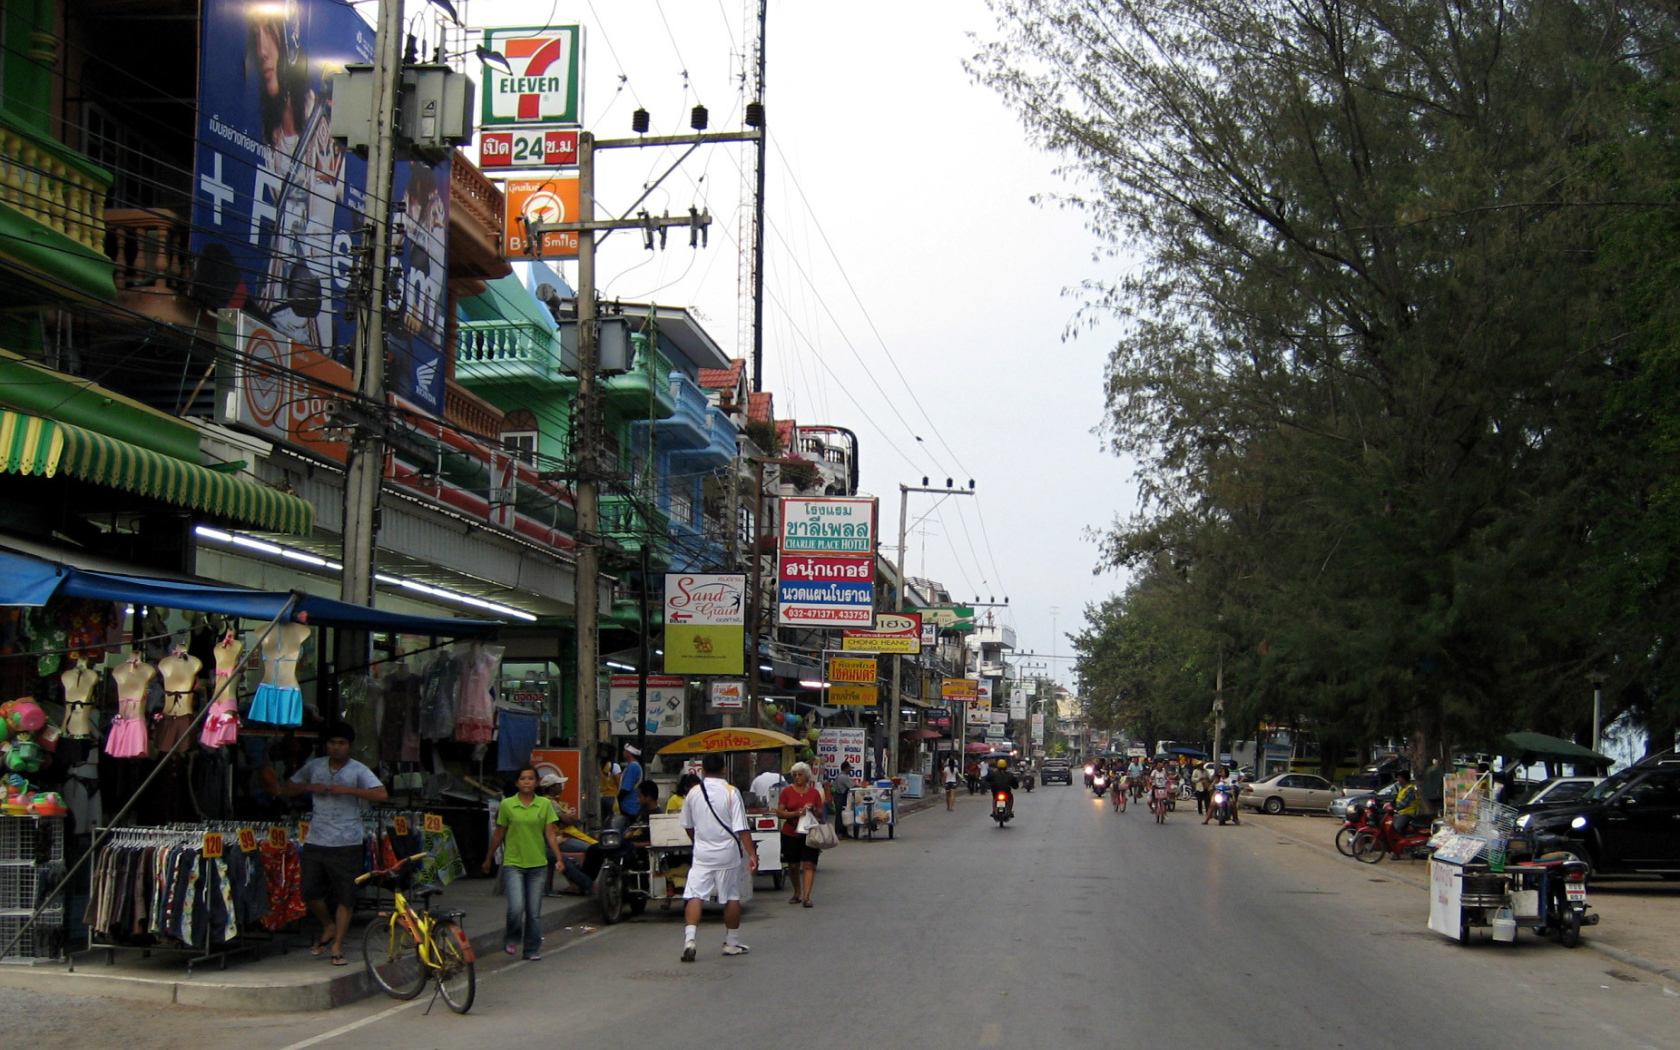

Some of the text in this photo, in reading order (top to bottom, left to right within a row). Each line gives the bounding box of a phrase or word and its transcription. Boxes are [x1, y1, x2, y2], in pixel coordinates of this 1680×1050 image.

[483, 138, 509, 155] เปิด
[513, 136, 543, 160] 24
[544, 233, 578, 249] Smile
[415, 384, 437, 406] HONDA
[804, 502, 852, 516] โรงแรม
[785, 538, 869, 551] CHARLIE PLACE HOTEL
[669, 577, 725, 608] Sand
[782, 583, 871, 603] นวดแผนโบราณ
[844, 754, 861, 763] 250
[427, 816, 441, 831] 29
[205, 835, 222, 854] 120
[241, 830, 255, 849] 99
[271, 829, 286, 847] 99
